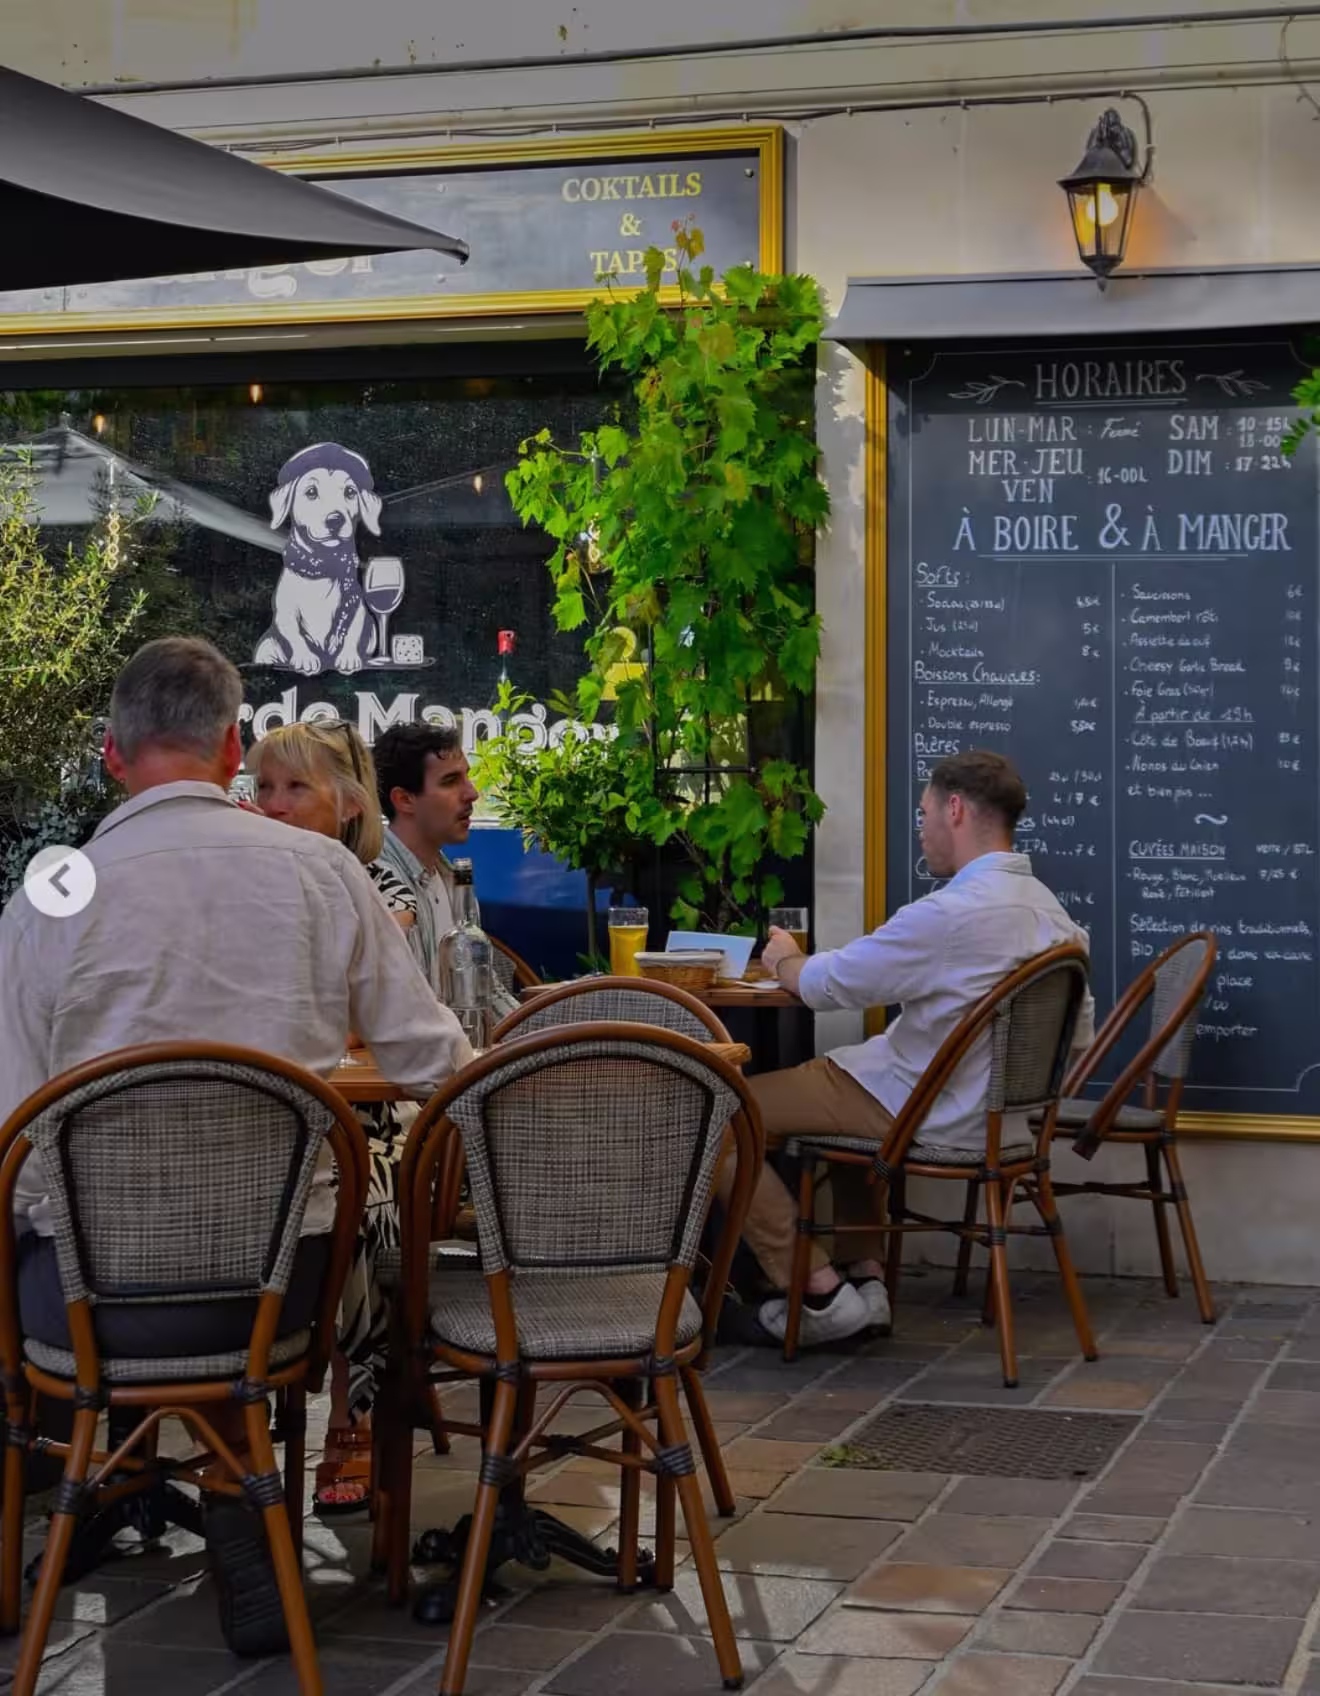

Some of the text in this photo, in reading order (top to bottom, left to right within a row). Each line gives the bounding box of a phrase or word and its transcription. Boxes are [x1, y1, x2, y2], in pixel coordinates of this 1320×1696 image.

[562, 172, 702, 202] COKTAILS
[620, 212, 641, 236] &
[1035, 360, 1188, 398] HORAIRES
[1169, 414, 1219, 441] SAM
[1168, 449, 1213, 475] DIM
[1001, 478, 1055, 503] VEN
[952, 503, 1291, 551] À BOIRE & À MANGER
[925, 616, 946, 632] Jus
[914, 660, 968, 681] Boissons
[914, 733, 960, 755] Bières
[1020, 838, 1048, 855] IPA
[1128, 838, 1174, 857] CUVÉES
[1180, 841, 1226, 857] MAISON
[1131, 940, 1153, 957] BIO
[1216, 974, 1254, 992] place
[1196, 1023, 1258, 1043] emporter
